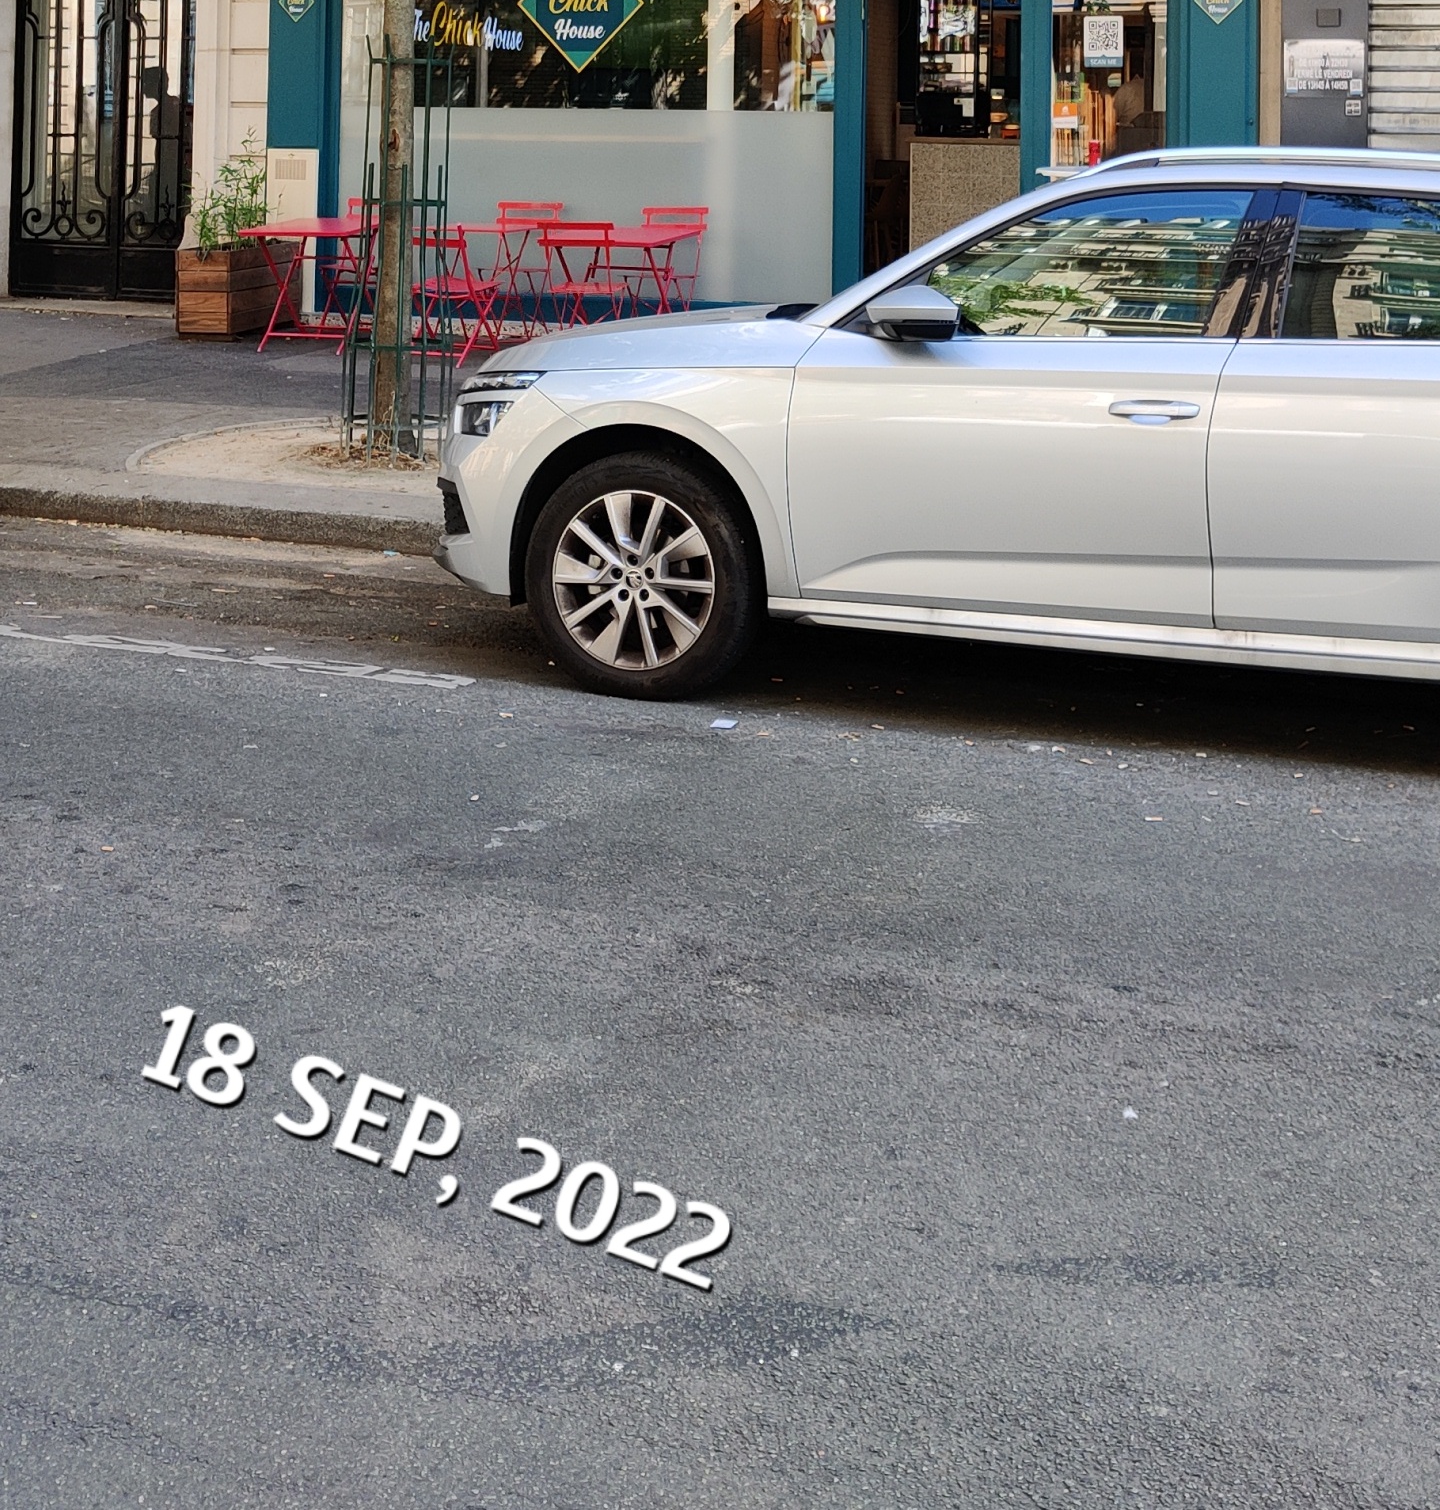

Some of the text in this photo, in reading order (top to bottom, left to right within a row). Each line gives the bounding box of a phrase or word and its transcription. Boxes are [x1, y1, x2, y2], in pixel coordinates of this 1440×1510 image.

[430, 1, 483, 47] Chick
[483, 16, 524, 51] House
[554, 19, 606, 40] House
